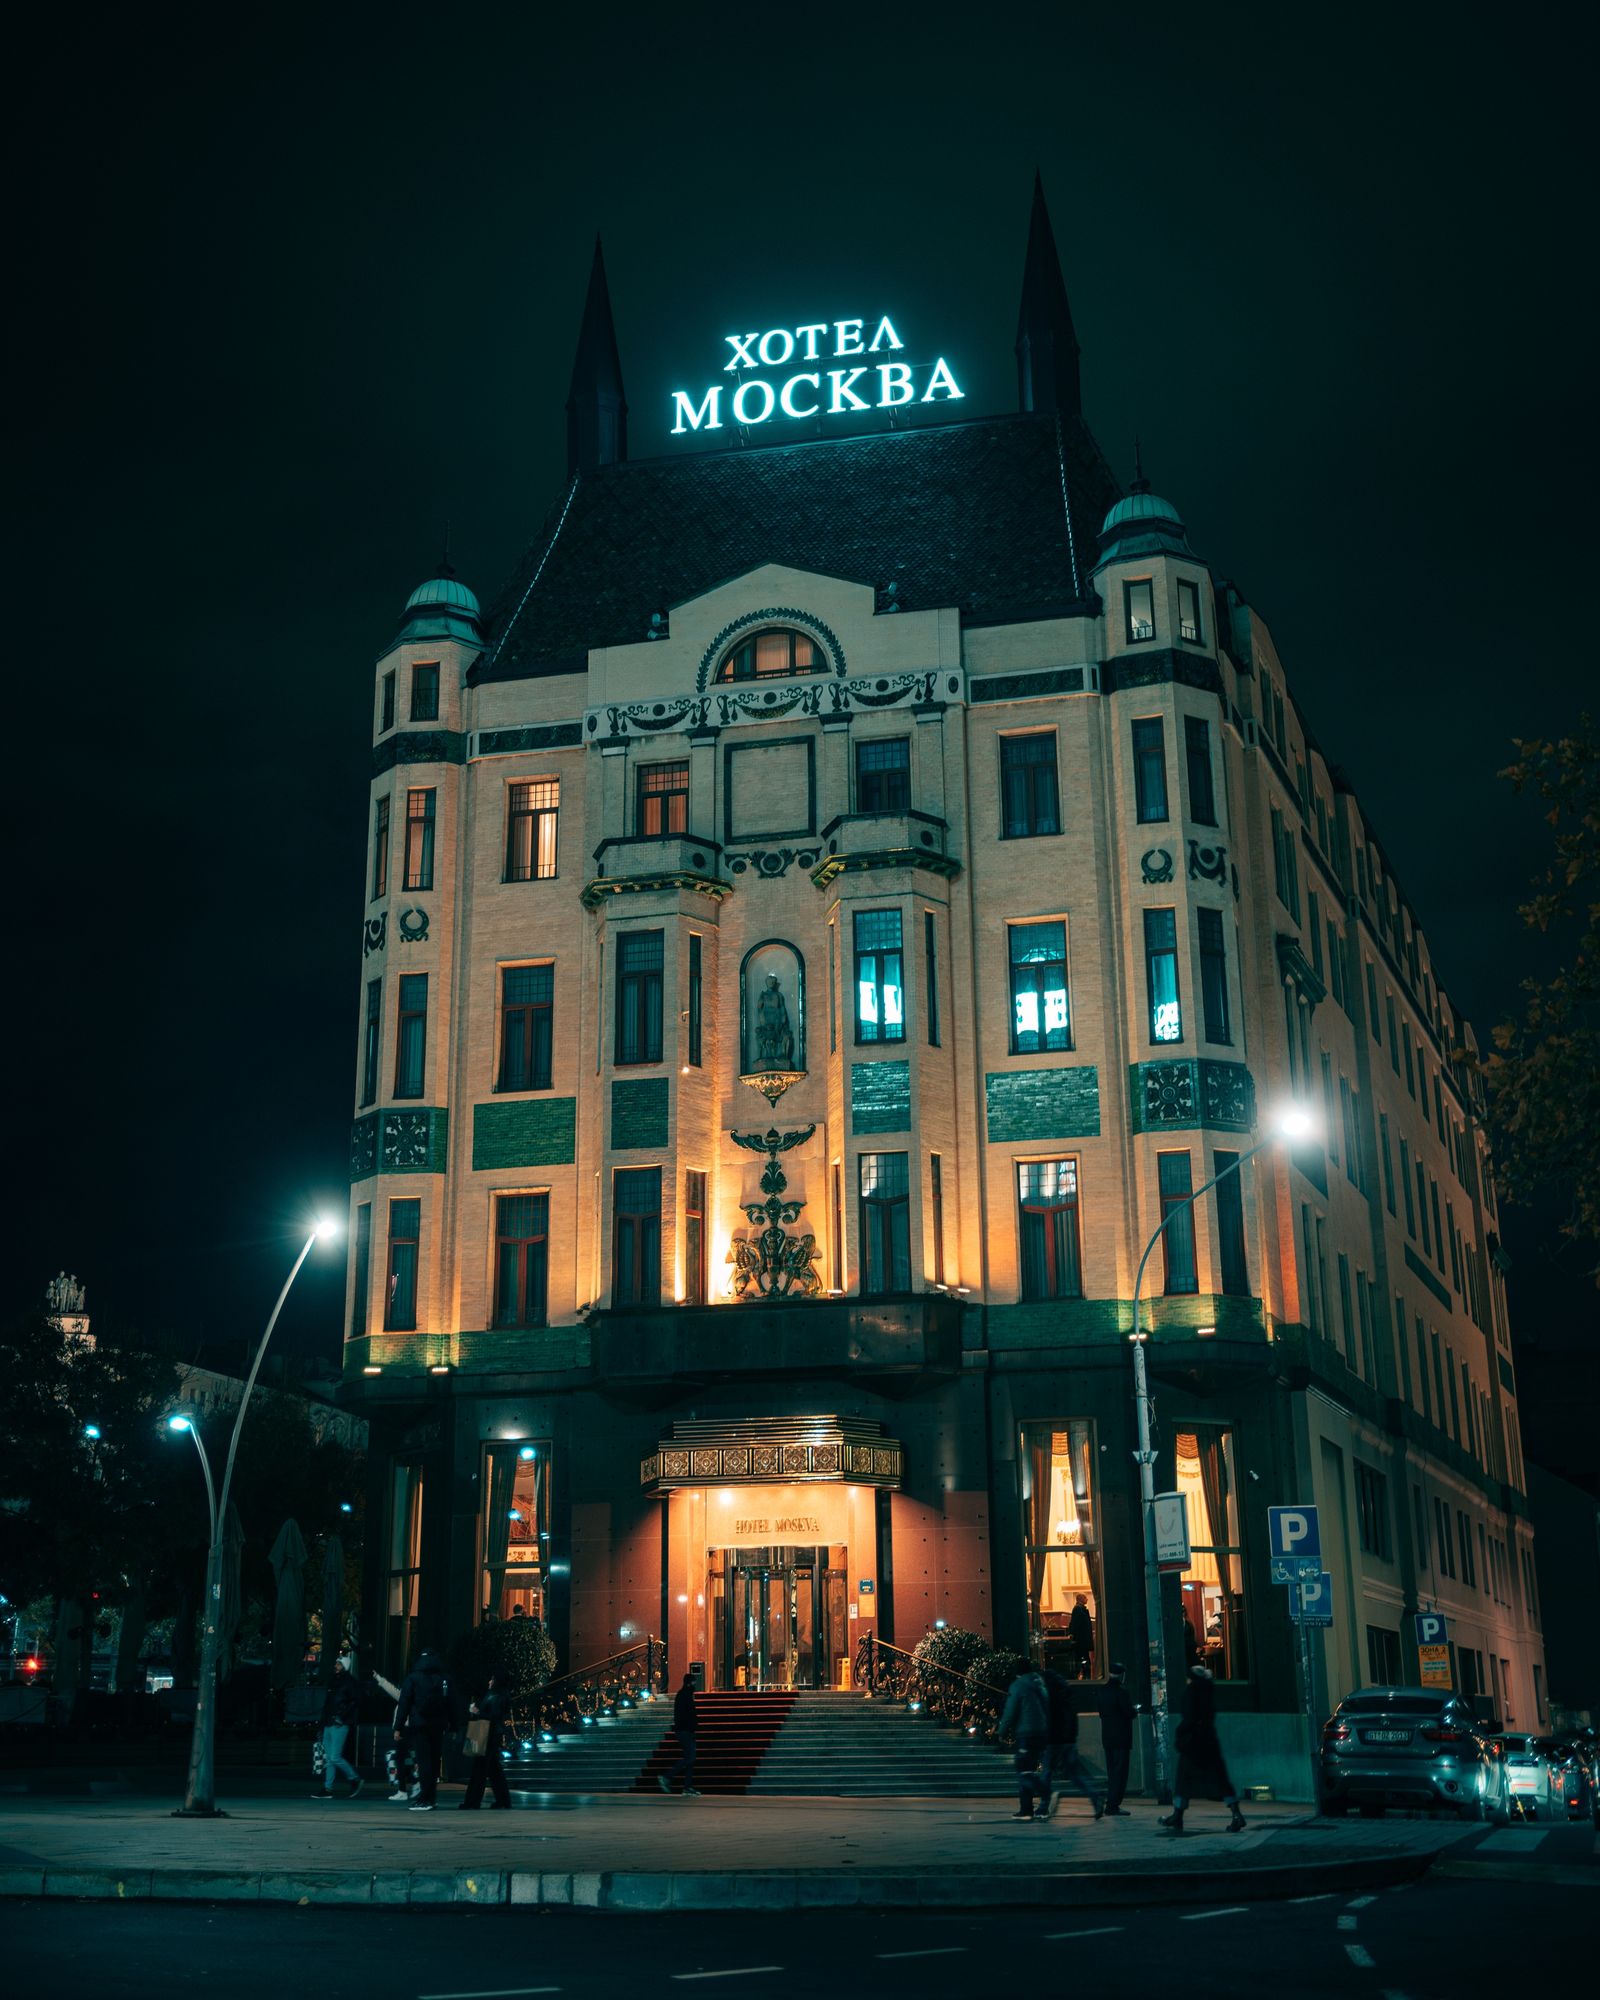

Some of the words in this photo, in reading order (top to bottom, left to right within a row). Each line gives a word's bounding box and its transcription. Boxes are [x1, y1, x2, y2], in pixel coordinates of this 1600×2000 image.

[723, 315, 904, 372] ХОТЕЛ
[670, 356, 966, 434] МОСКВА
[736, 1519, 772, 1534] HOTEL
[775, 1517, 820, 1533] MOSKVA
[1280, 1512, 1308, 1552] P
[1301, 1583, 1322, 1611] P
[1422, 1618, 1440, 1641] P
